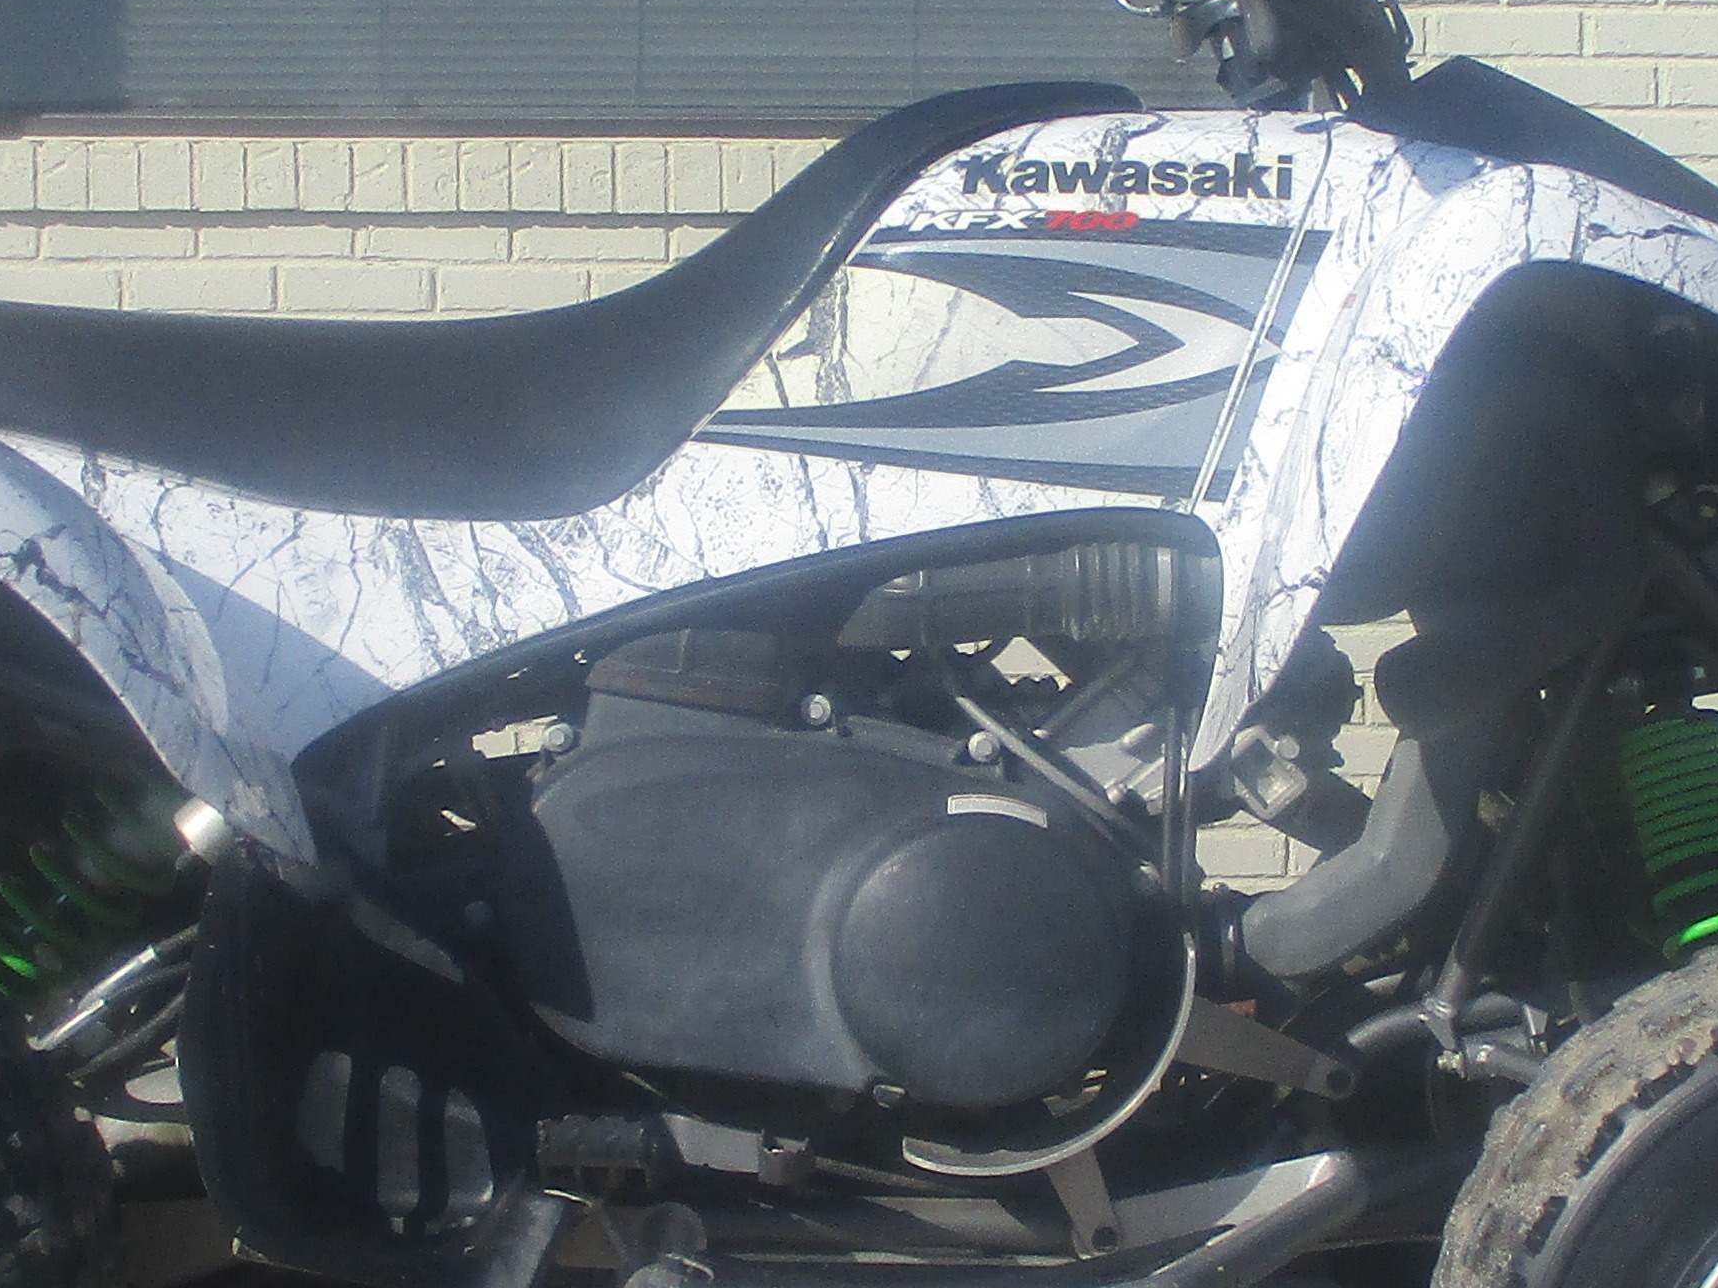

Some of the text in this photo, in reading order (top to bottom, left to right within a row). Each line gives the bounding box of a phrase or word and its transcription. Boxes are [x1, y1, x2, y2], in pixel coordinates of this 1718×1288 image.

[962, 153, 1294, 200] Kawasaki
[908, 209, 1140, 232] KFX 700
